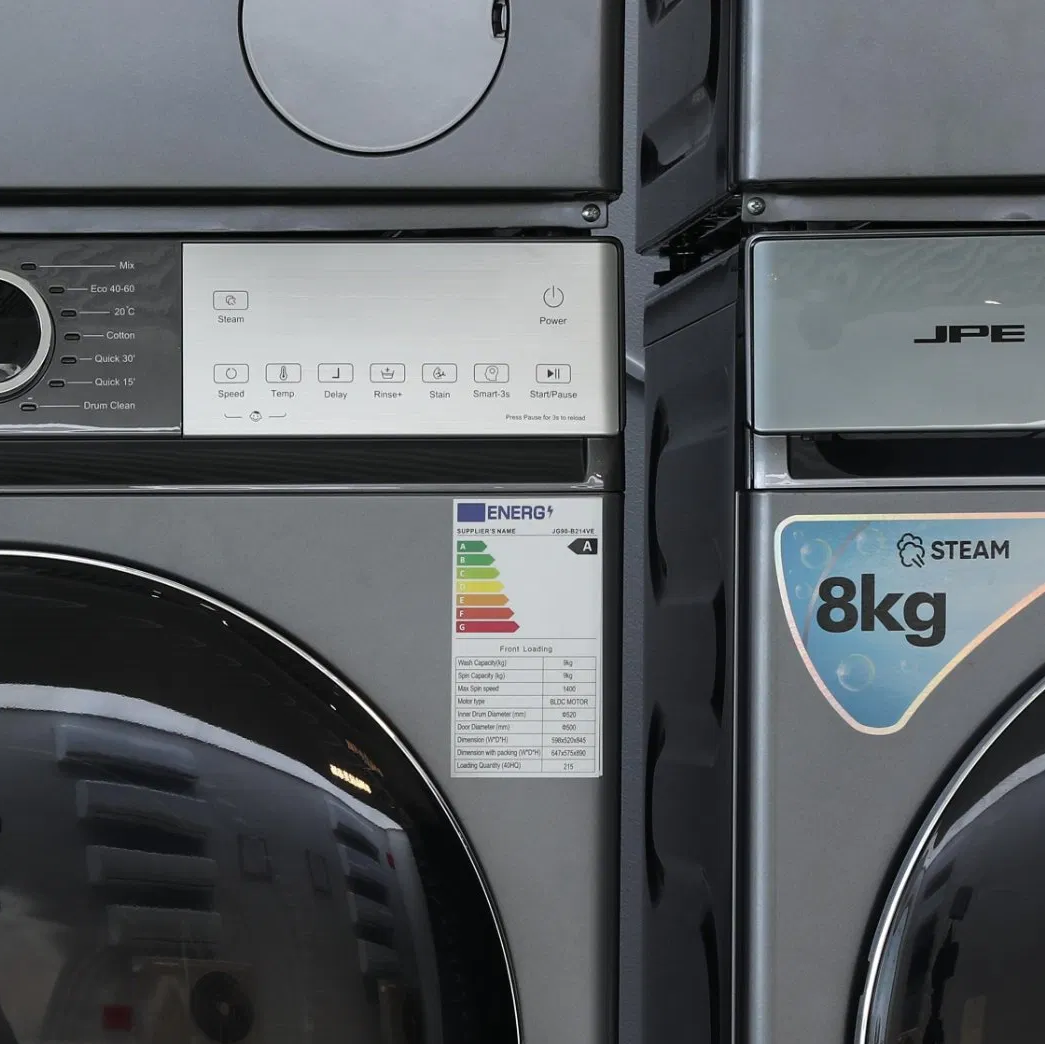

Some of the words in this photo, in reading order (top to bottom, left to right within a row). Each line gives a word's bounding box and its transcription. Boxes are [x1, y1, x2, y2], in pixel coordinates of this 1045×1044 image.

[91, 285, 107, 293] Eco
[110, 285, 135, 293] 40-60
[218, 315, 244, 323] Steam
[539, 317, 567, 325] Power
[106, 331, 135, 340] Cotton
[914, 325, 1025, 343] JPE
[95, 355, 120, 363] Quick
[95, 378, 120, 386] Quick
[218, 390, 245, 399] Speed
[271, 390, 294, 399] Temp
[324, 391, 348, 399] Delay
[374, 391, 402, 399] Rinse+
[429, 391, 450, 399] Stain
[473, 390, 510, 398] Smart-3s
[530, 390, 577, 399] Start/Pause
[487, 506, 545, 519] ENERG
[583, 541, 592, 551] A
[931, 540, 1010, 560] STEAM
[816, 573, 946, 647] 8kg
